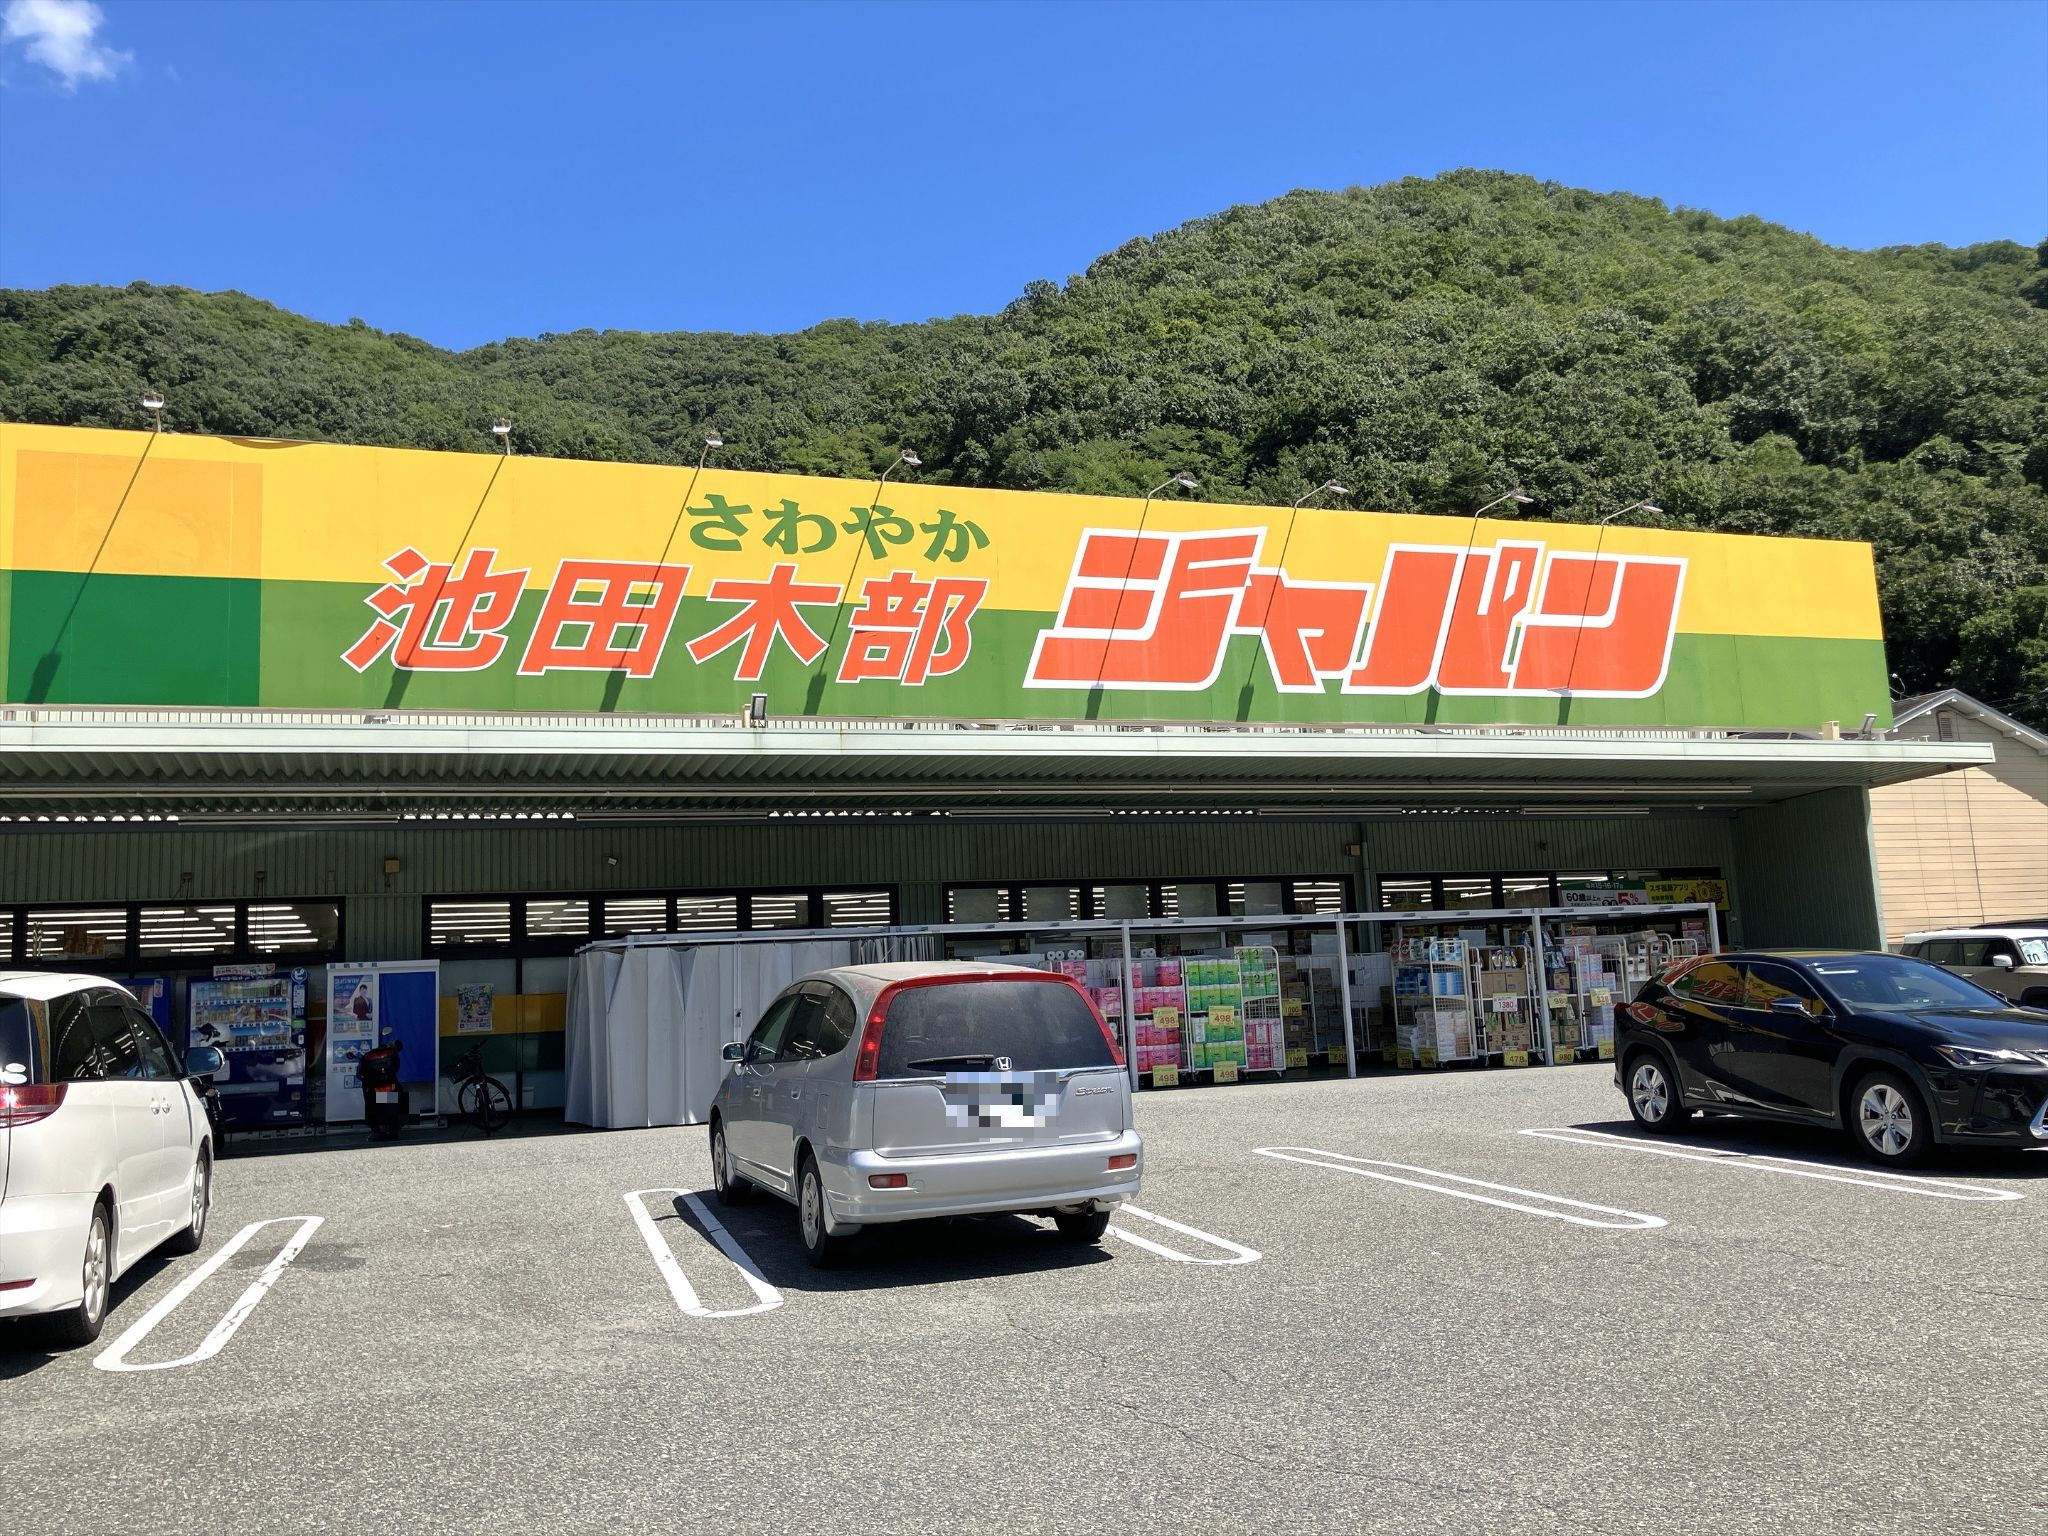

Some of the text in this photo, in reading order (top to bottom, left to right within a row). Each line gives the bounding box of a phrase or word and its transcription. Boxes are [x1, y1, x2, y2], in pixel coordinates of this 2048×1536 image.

[685, 493, 990, 562] さわやか
[341, 545, 990, 687] 池田木部
[1022, 526, 1688, 700] ジャパン
[1160, 1017, 1175, 1025] 498
[1159, 1074, 1175, 1082] 498
[1220, 1071, 1235, 1079] 498
